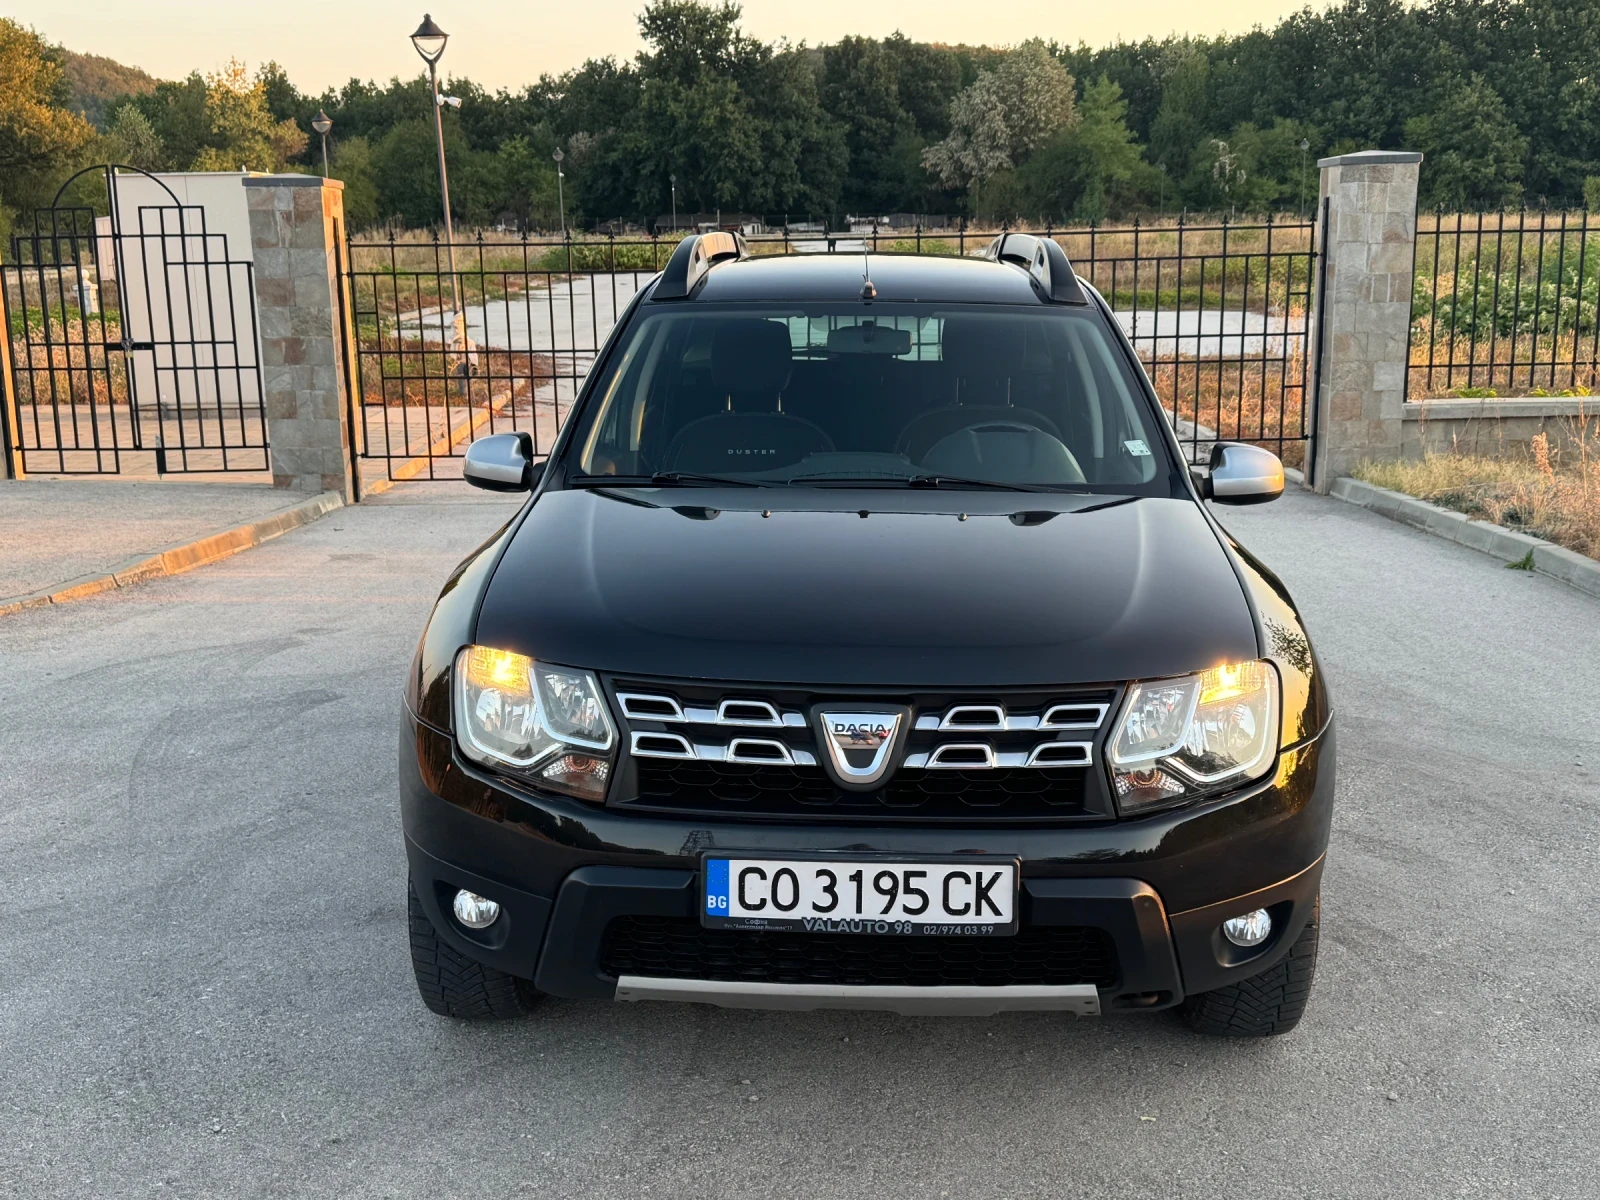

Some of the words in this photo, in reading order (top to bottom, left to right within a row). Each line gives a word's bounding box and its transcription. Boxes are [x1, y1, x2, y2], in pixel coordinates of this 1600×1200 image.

[834, 723, 886, 733] DACIA
[812, 868, 930, 916] 3195
[942, 870, 1004, 917] CK
[707, 895, 727, 909] BG
[802, 918, 889, 934] VALAUTO
[894, 921, 913, 935] 98
[923, 925, 962, 935] 02/974
[964, 925, 978, 935] 03
[981, 925, 994, 935] 99
